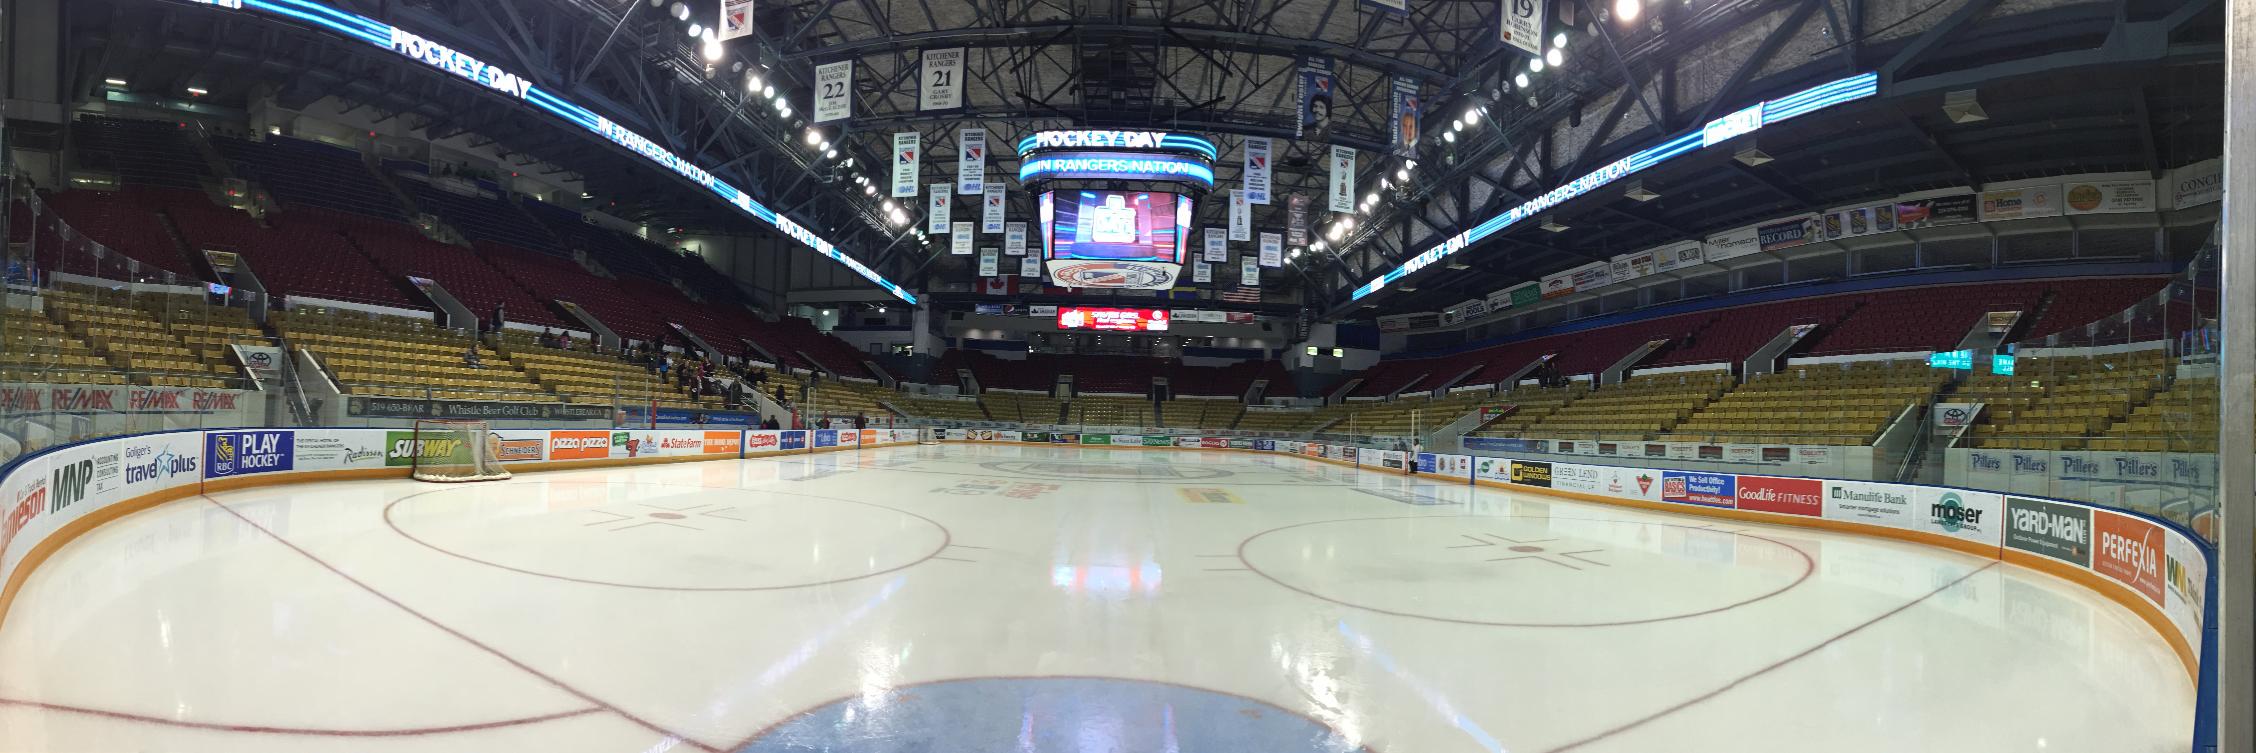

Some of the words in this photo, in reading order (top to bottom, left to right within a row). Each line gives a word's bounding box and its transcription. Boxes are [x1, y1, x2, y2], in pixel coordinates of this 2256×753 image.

[1512, 0, 1533, 18] 19
[391, 26, 484, 81] HOCKEY
[489, 66, 532, 99] DAY
[926, 51, 960, 61] KITCHENER
[929, 60, 956, 68] RANGERS
[818, 63, 849, 76] KITCHENER
[821, 72, 846, 82] RANGERS
[932, 70, 952, 87] 21
[823, 81, 845, 100] 22
[1036, 131, 1120, 148] HOCKEY
[1124, 131, 1167, 148] DAY
[599, 115, 613, 138] IN
[614, 123, 674, 168] RANGERS
[676, 157, 715, 188] NATION
[1037, 160, 1050, 170] IN
[1056, 160, 1128, 172] RANGERS
[1132, 160, 1188, 173] NATION
[1511, 206, 1523, 222] IN
[1523, 180, 1578, 216] RANGERS
[1579, 157, 1631, 192] NATION
[776, 213, 816, 248] HOCKEY
[817, 236, 834, 258] DAY
[1760, 229, 1801, 245] RECORD
[1403, 240, 1444, 275] HOCKEY
[1447, 229, 1472, 256] DAY
[52, 388, 113, 410] RE/MAX
[128, 390, 181, 410] RE/MAX
[192, 390, 237, 410] RE/MAX
[371, 402, 385, 411] 519
[448, 404, 481, 415] Whistle
[483, 405, 501, 415] Bear
[502, 405, 520, 415] Golf
[520, 405, 538, 416] Club
[242, 434, 280, 454] PLAY
[389, 439, 461, 458] SUBWAY
[242, 454, 280, 469] HOCKEY
[344, 445, 384, 464] Radisson
[1971, 453, 2000, 469] Piller's
[2013, 454, 2047, 472] Piller's
[126, 459, 157, 484] travel
[171, 454, 196, 477] plus
[217, 461, 233, 472] RBC
[1523, 465, 1548, 474] GOLDEN
[1555, 466, 1577, 477] GREEN
[2060, 456, 2099, 474] Piller's
[2115, 457, 2158, 477] Piller's
[1523, 472, 1551, 481] WINDOWS
[1709, 477, 1725, 485] Office
[51, 459, 93, 514] MNP
[1664, 480, 1685, 494] BASICS
[1689, 484, 1720, 494] Productivity!
[1738, 487, 1776, 502] GoodLife
[1777, 492, 1819, 506] FITNESS
[1843, 490, 1883, 502] Manulife
[1884, 493, 1907, 505] Bank
[1931, 502, 1983, 524] moser
[2102, 529, 2157, 580] PERFEXIA
